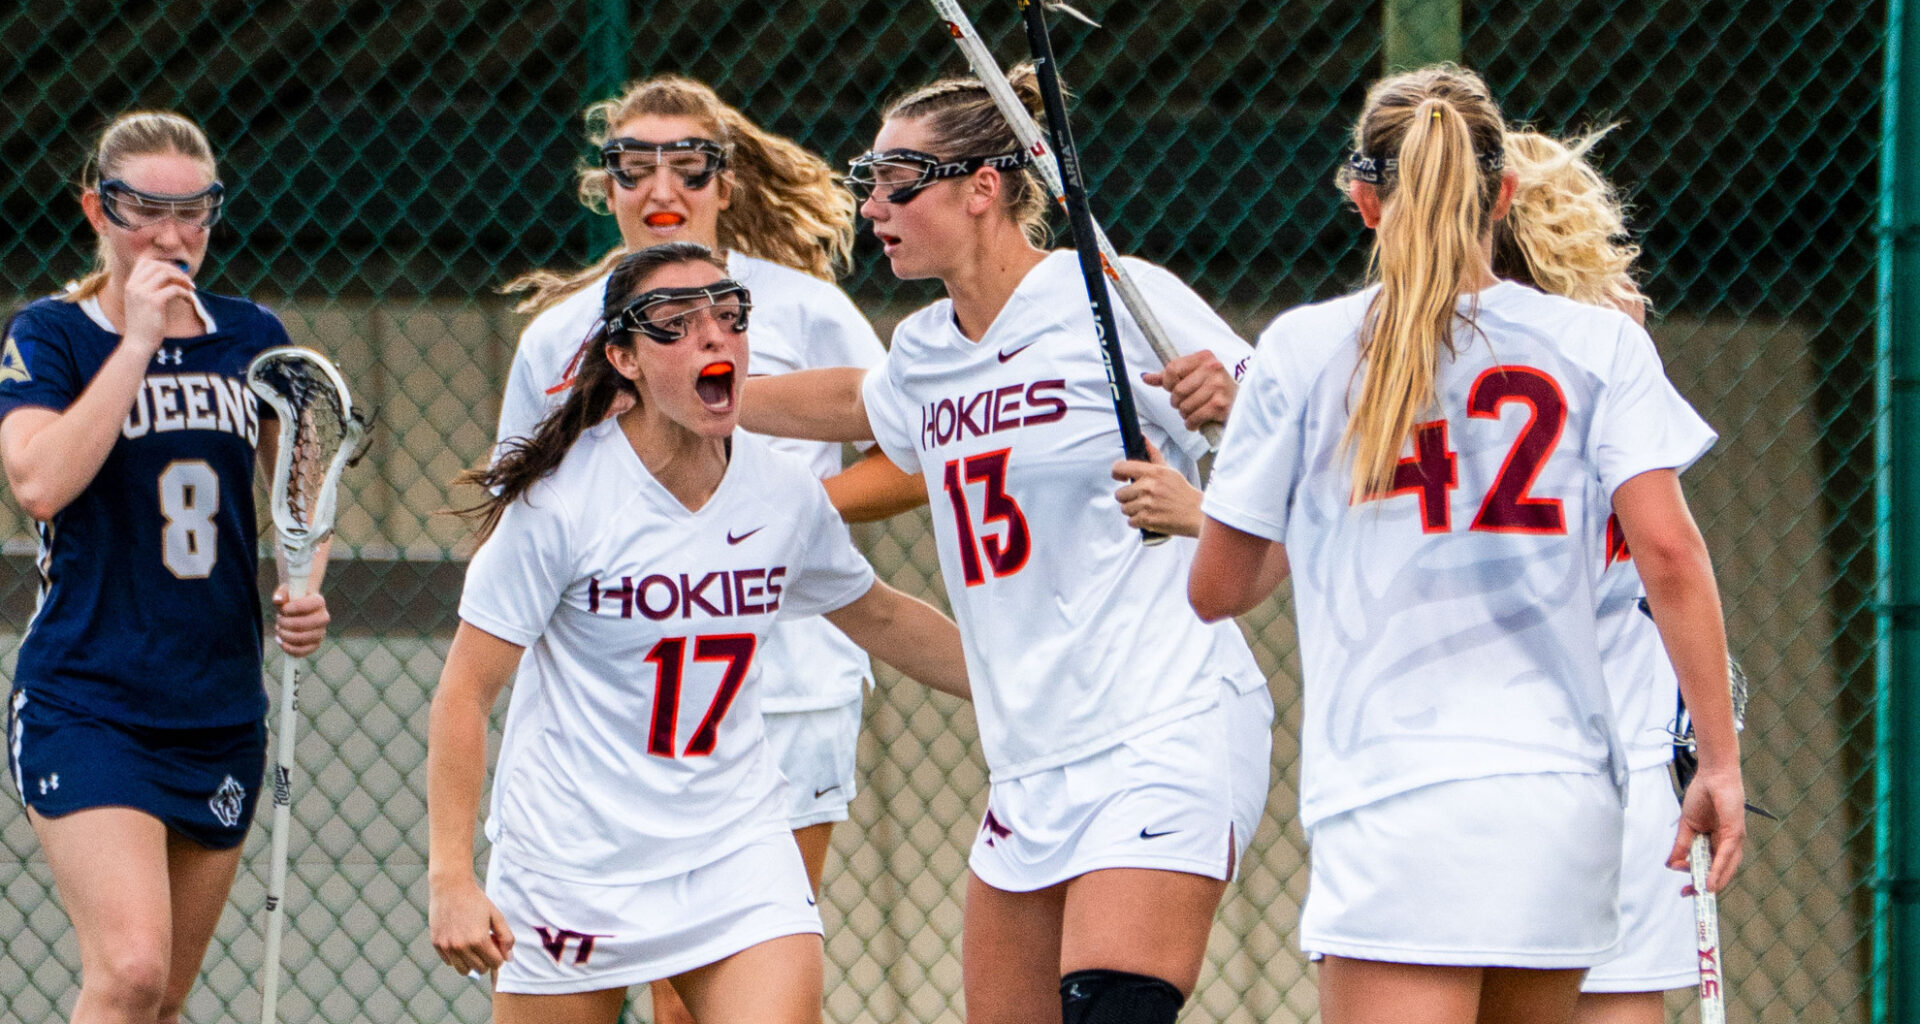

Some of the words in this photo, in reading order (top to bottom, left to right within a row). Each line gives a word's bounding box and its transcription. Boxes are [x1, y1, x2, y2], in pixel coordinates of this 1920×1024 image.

[122, 373, 259, 449] UEENS
[922, 379, 1068, 451] HOKIES
[1349, 365, 1568, 535] 42
[158, 458, 219, 578] 8
[944, 447, 1031, 587] 13
[588, 567, 786, 621] HOKIES
[643, 633, 757, 759] 17
[532, 926, 616, 967] VT
[1698, 946, 1720, 999] STX
